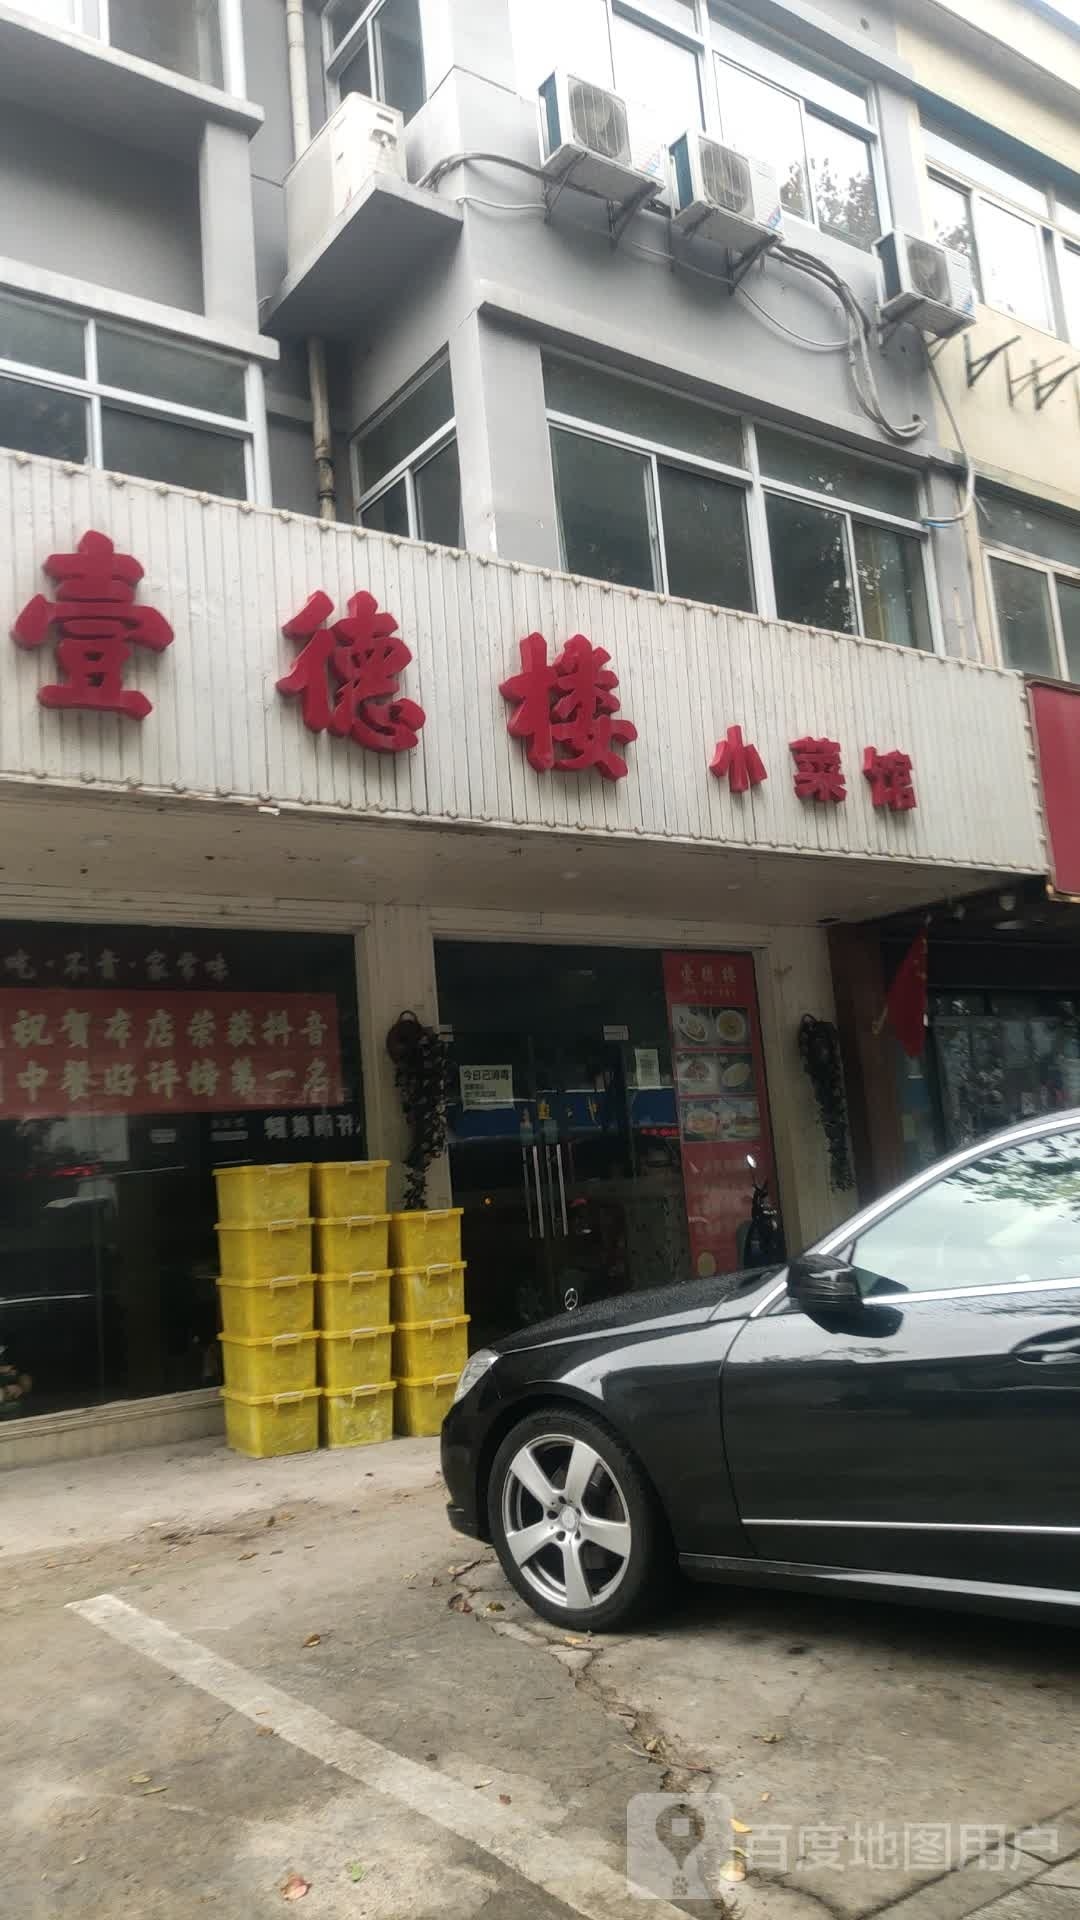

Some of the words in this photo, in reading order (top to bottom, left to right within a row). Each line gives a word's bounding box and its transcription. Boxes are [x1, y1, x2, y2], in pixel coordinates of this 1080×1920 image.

[11, 529, 637, 782] 壹德楼
[708, 725, 917, 813] 小菜馆
[0, 1056, 331, 1104] 中餐好评榜第一名
